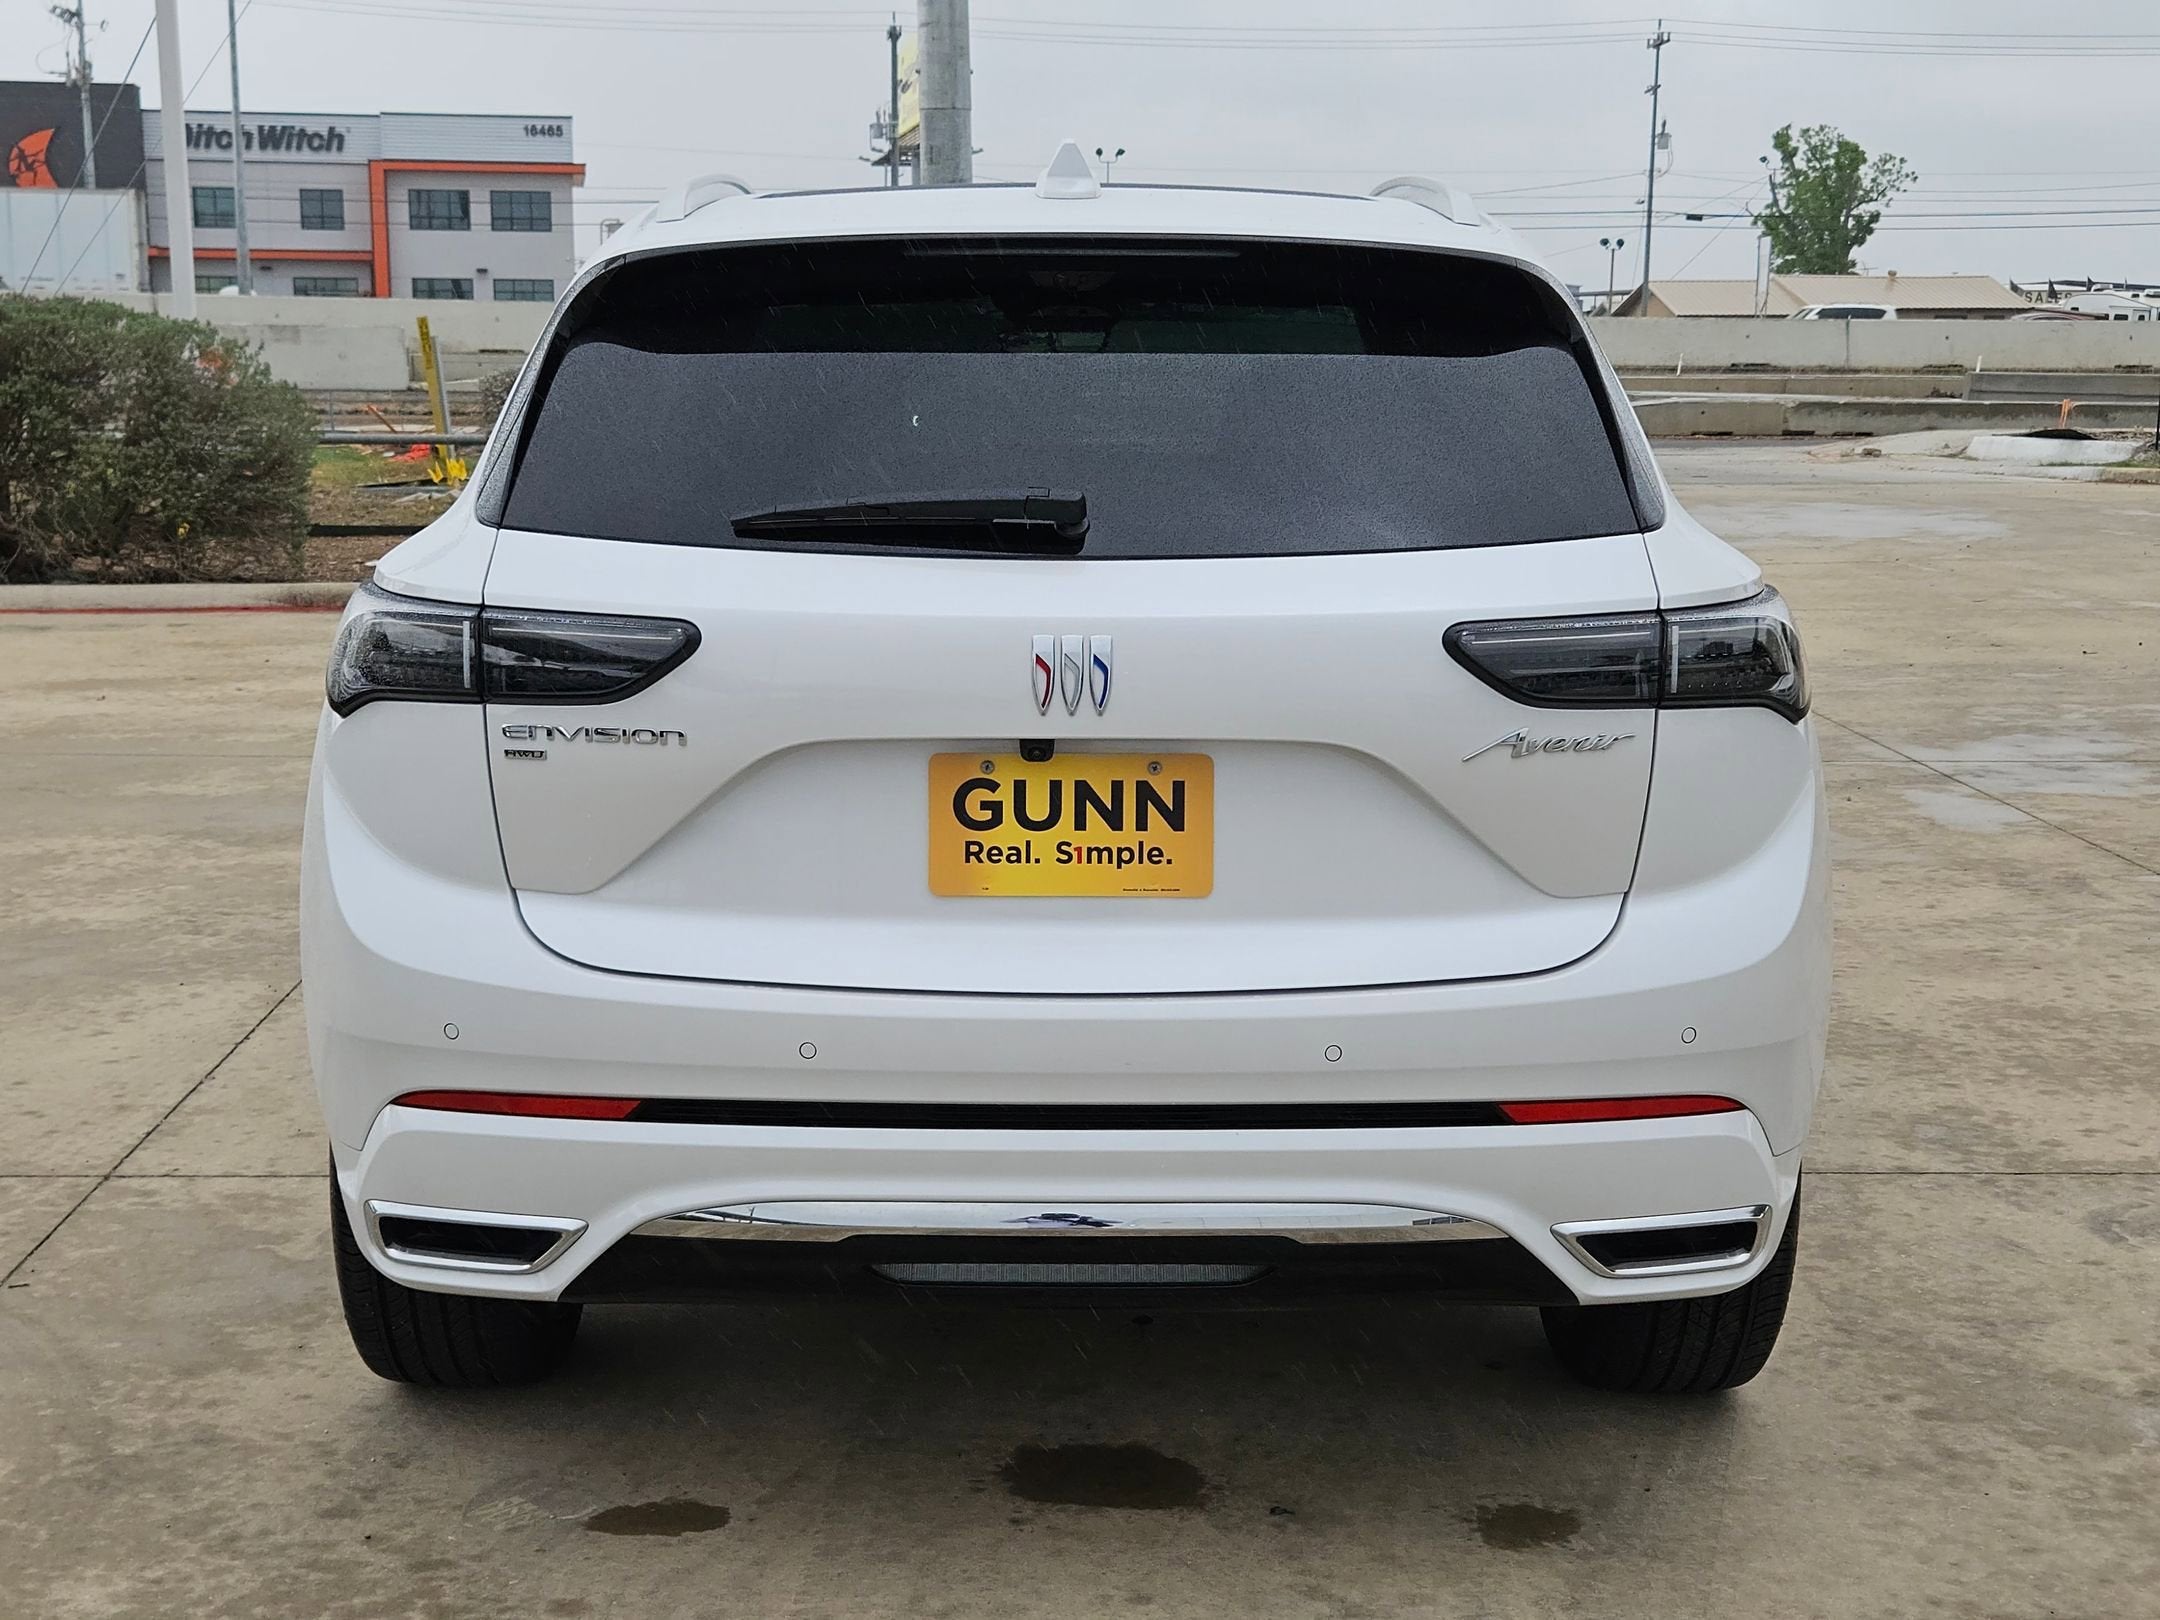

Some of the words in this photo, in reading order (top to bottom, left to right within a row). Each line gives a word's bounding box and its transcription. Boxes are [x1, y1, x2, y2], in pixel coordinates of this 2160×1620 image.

[256, 125, 345, 153] Witch
[501, 724, 687, 746] ENVISION
[1461, 727, 1637, 762] Avenir
[953, 777, 1185, 832] GUNN
[964, 840, 1040, 864] Real.
[1055, 840, 1173, 869] S1mple.
